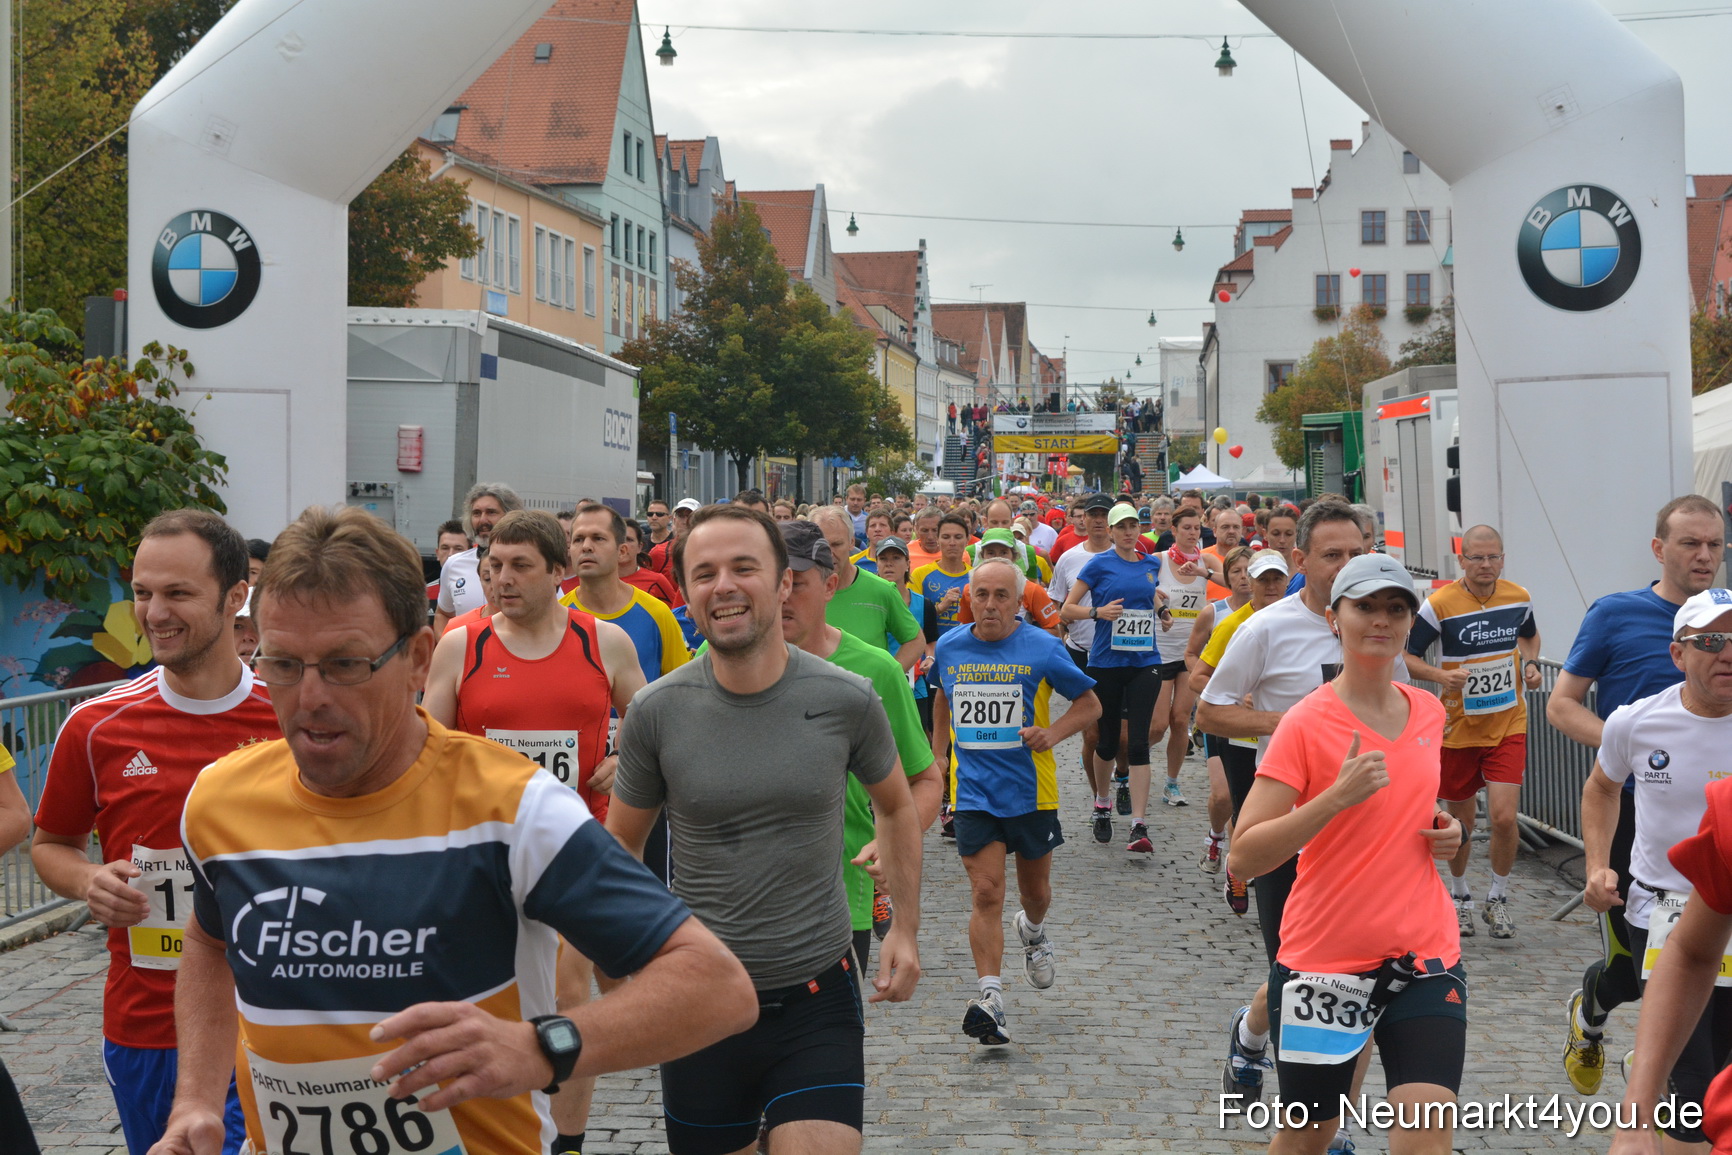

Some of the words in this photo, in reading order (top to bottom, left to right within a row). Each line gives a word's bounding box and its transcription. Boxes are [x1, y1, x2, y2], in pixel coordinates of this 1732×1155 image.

[1527, 187, 1633, 231] BMW
[159, 212, 252, 252] BMW
[603, 407, 632, 451] BOCK
[1034, 438, 1077, 449] START
[1181, 595, 1198, 609] 27
[1117, 619, 1151, 635] 2412
[1471, 627, 1517, 641] Fischer
[1476, 636, 1516, 646] AUTOMOBILE
[958, 664, 1032, 675] NEUMARKTER
[956, 673, 1015, 682] STADTLAUF
[1467, 670, 1512, 695] 2324
[1476, 696, 1508, 708] Christian
[960, 701, 1015, 724] 2807
[518, 739, 562, 747] Neumarkt
[976, 731, 997, 740] Gerd
[122, 765, 158, 777] adidas
[257, 920, 437, 957] Fischer
[271, 961, 424, 978] AUTOMOBILE
[251, 1067, 296, 1095] PARTL
[269, 1094, 434, 1155] 2786
